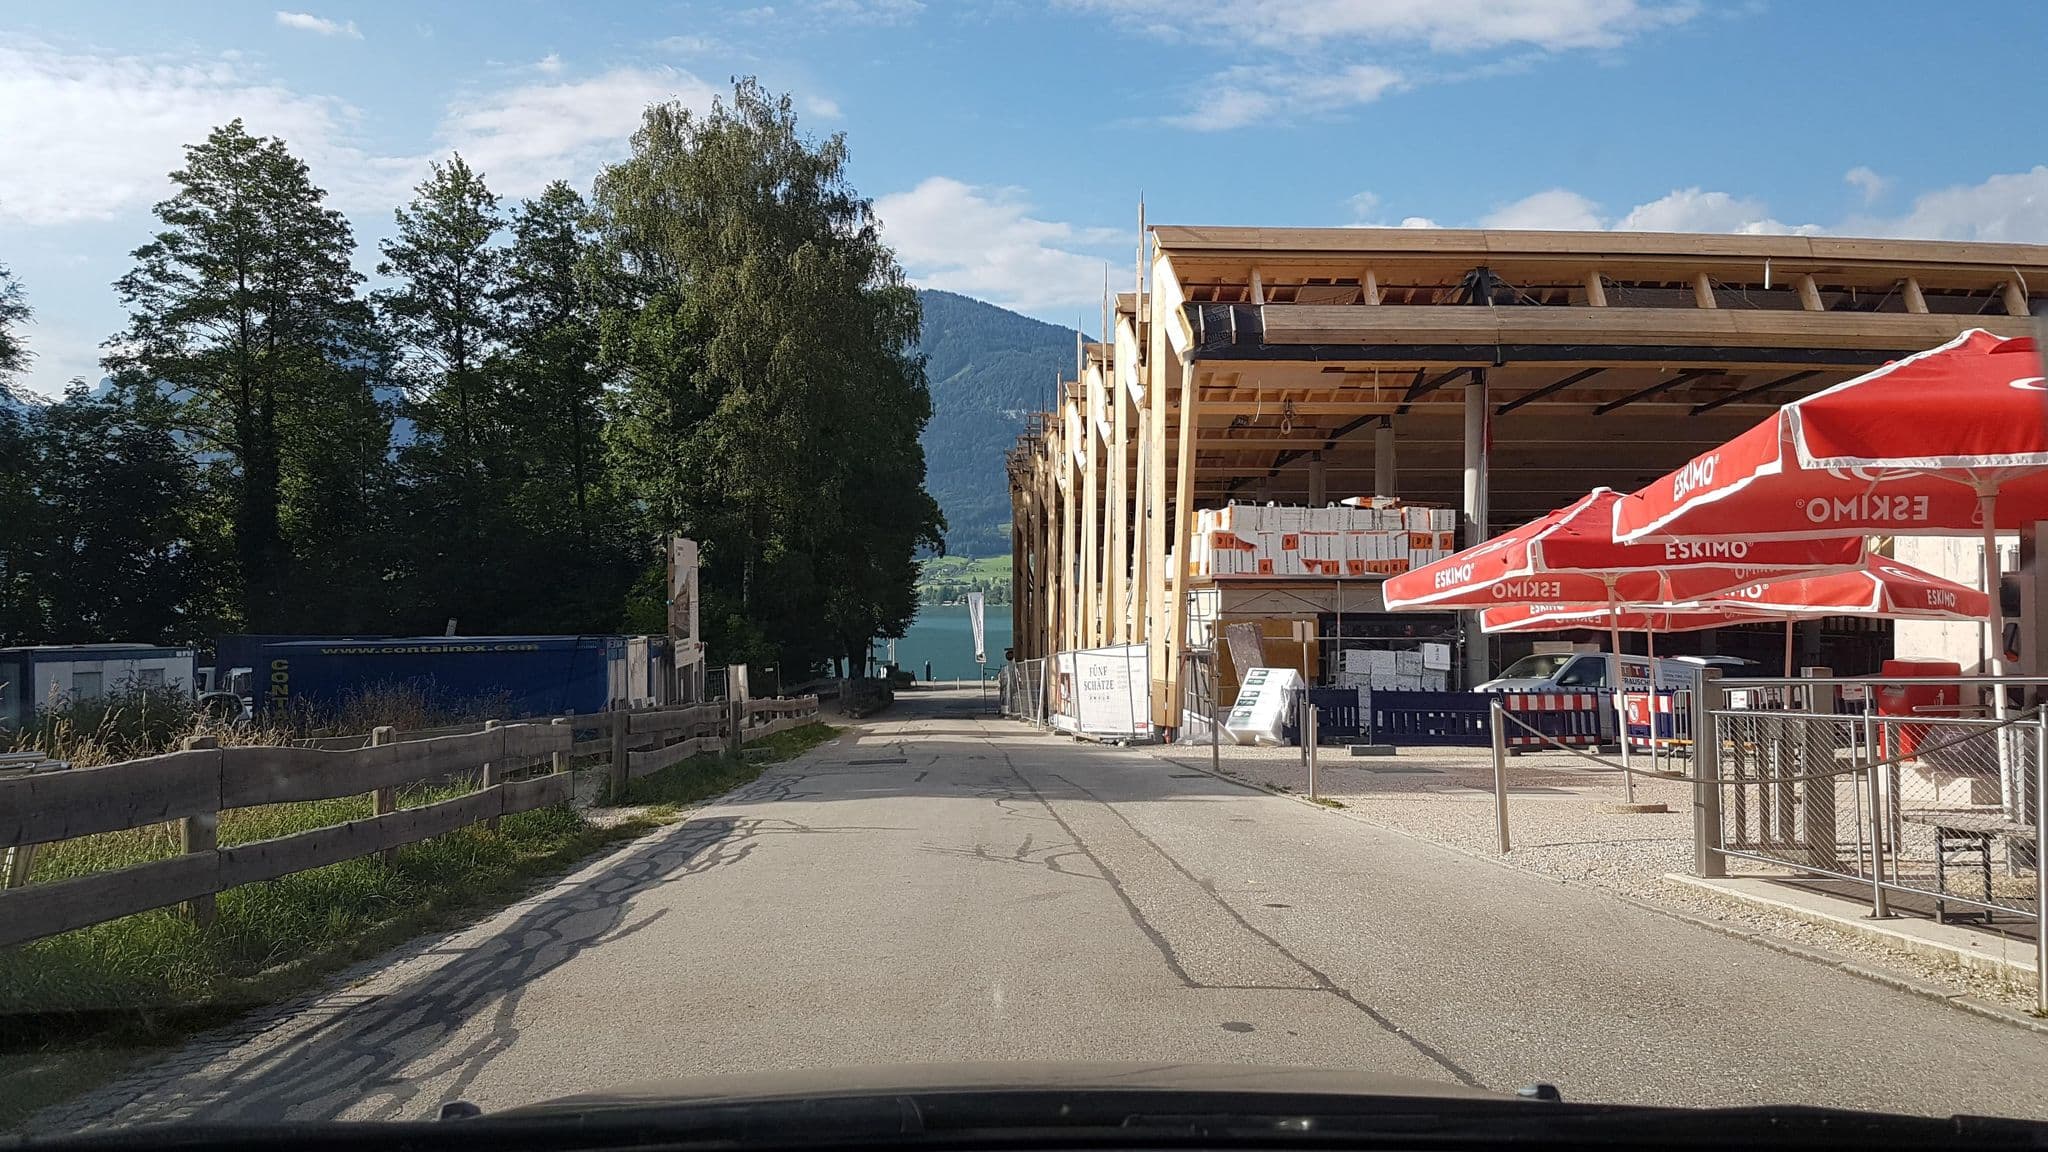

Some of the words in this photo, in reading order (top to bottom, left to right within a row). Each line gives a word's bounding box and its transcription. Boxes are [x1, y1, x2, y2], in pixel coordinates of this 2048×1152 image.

[321, 643, 539, 655] www.containex.com
[1089, 664, 1108, 677] FÜNF
[1083, 678, 1114, 691] SCHÄTZE
